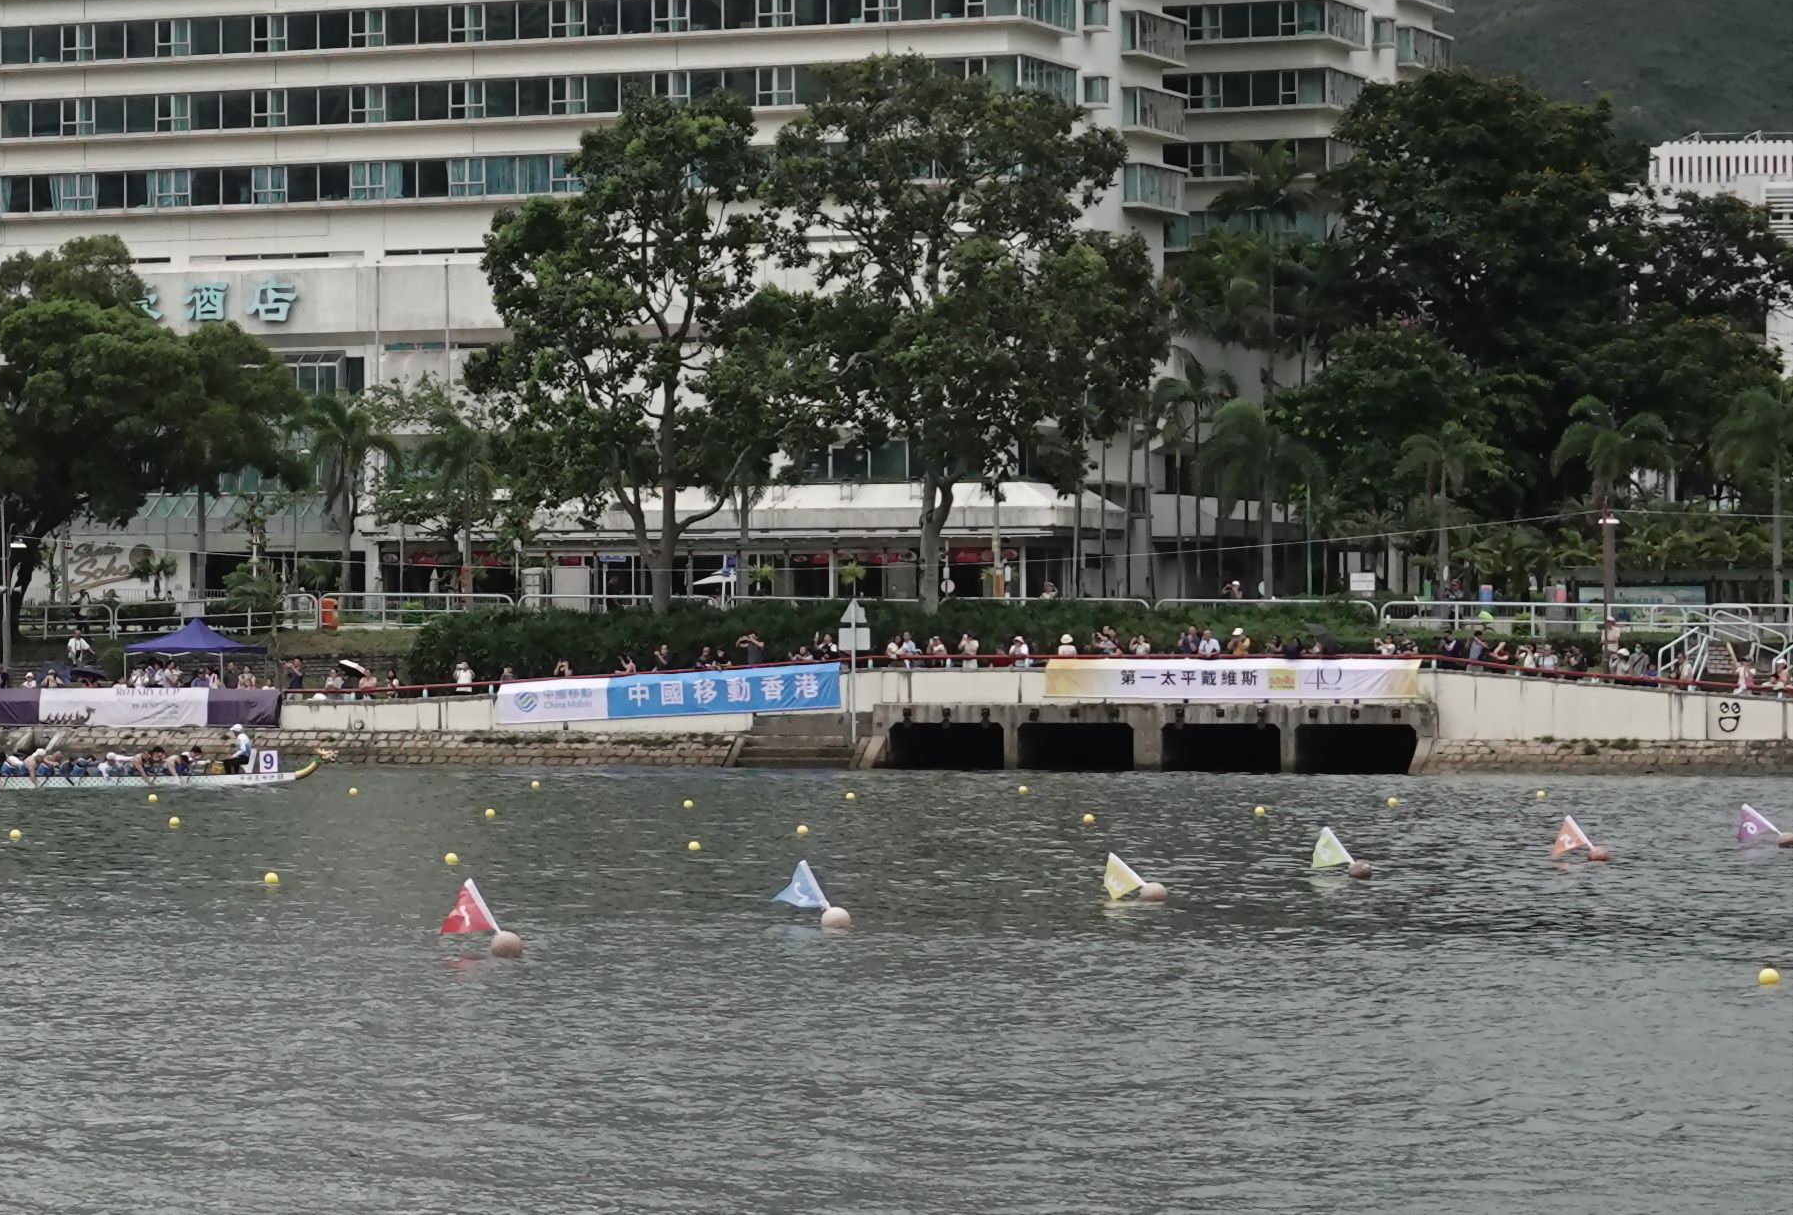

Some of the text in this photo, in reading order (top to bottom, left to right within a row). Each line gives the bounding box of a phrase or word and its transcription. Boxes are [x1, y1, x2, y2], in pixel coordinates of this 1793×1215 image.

[69, 555, 130, 585] Soho
[628, 673, 819, 707] 中國移動香港
[1120, 669, 1258, 687] 第一太平戴維斯
[263, 753, 274, 770] 9
